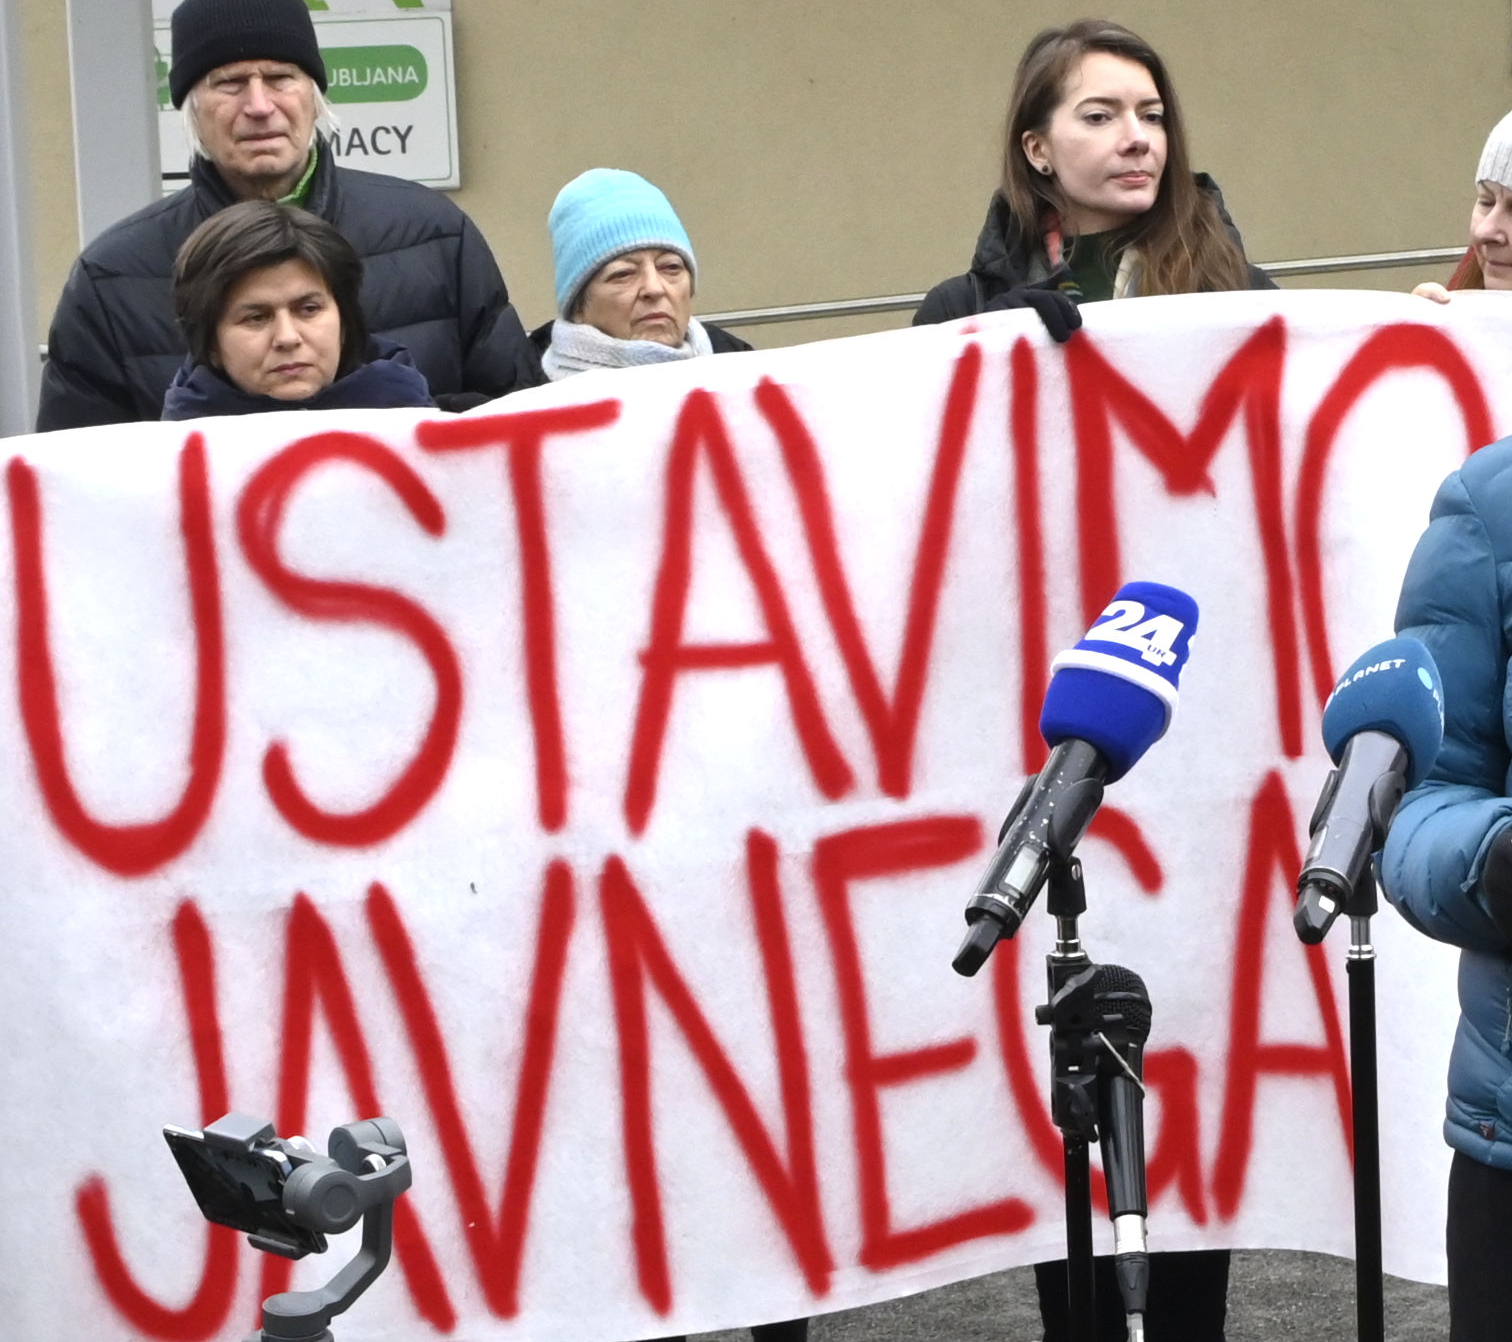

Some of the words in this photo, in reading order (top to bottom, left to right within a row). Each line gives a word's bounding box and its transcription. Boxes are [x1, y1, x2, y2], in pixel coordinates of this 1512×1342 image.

[327, 65, 419, 87] UBLJANA
[6, 311, 1492, 878] USTAVIMO
[1084, 599, 1185, 666] 24
[1334, 658, 1407, 696] PLANET
